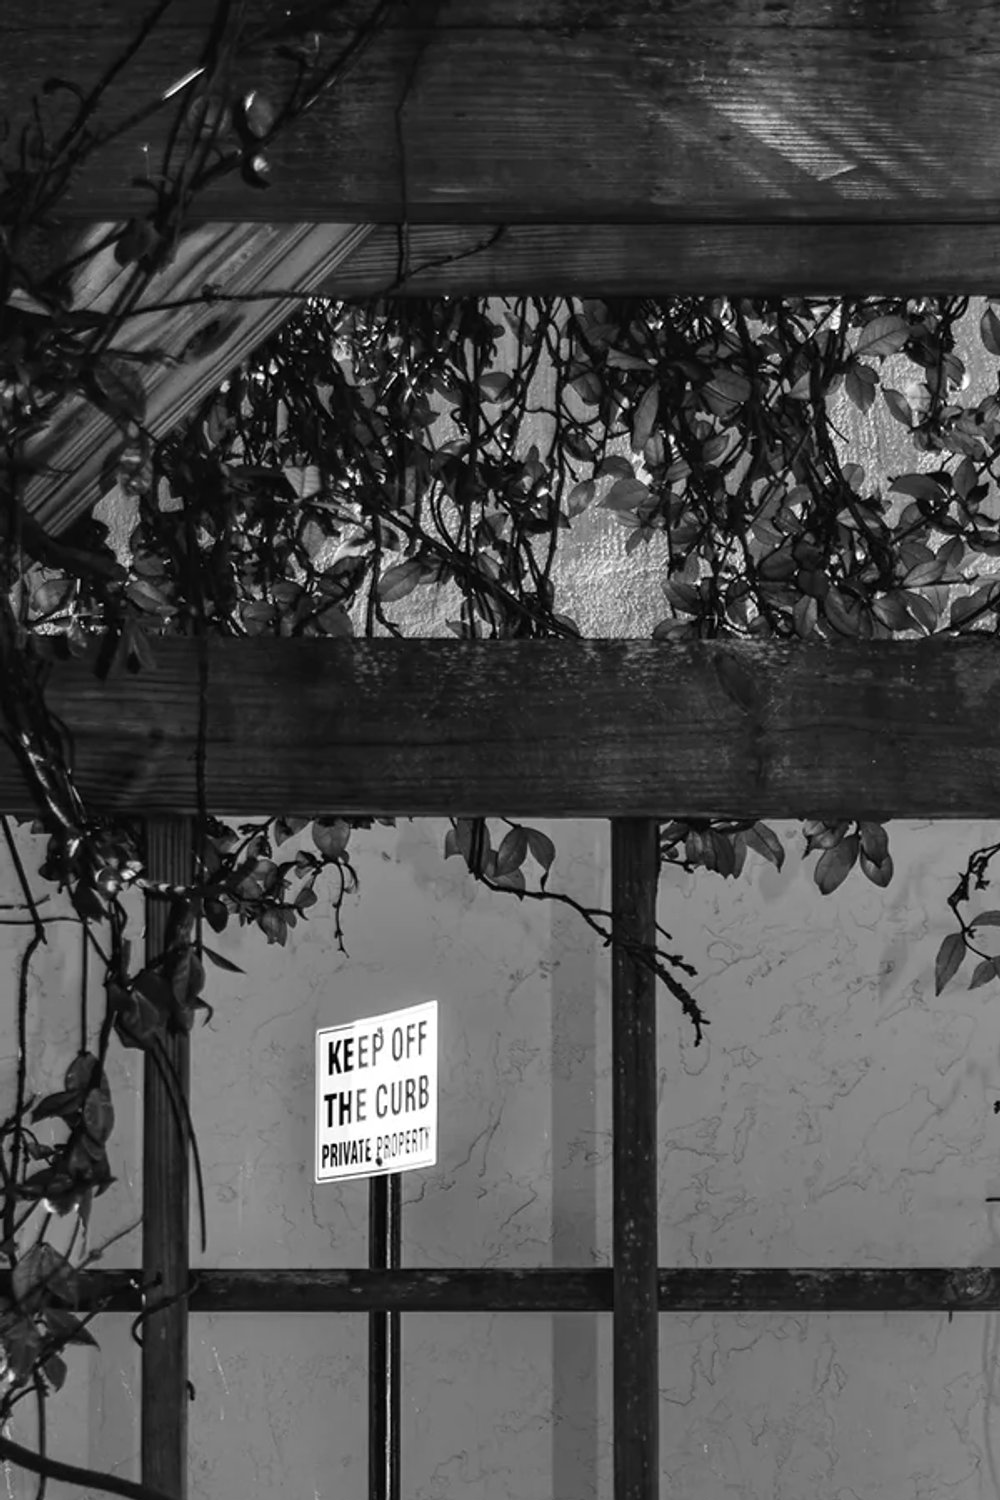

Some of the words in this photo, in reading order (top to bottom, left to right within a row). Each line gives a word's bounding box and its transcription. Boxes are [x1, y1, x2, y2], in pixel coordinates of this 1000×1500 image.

[327, 1032, 384, 1076] KEEP
[391, 1021, 428, 1061] OFF
[323, 1088, 367, 1128] THE
[375, 1075, 430, 1119] CURB
[321, 1137, 372, 1169] PRIVATE
[376, 1126, 431, 1160] PROPERTY
